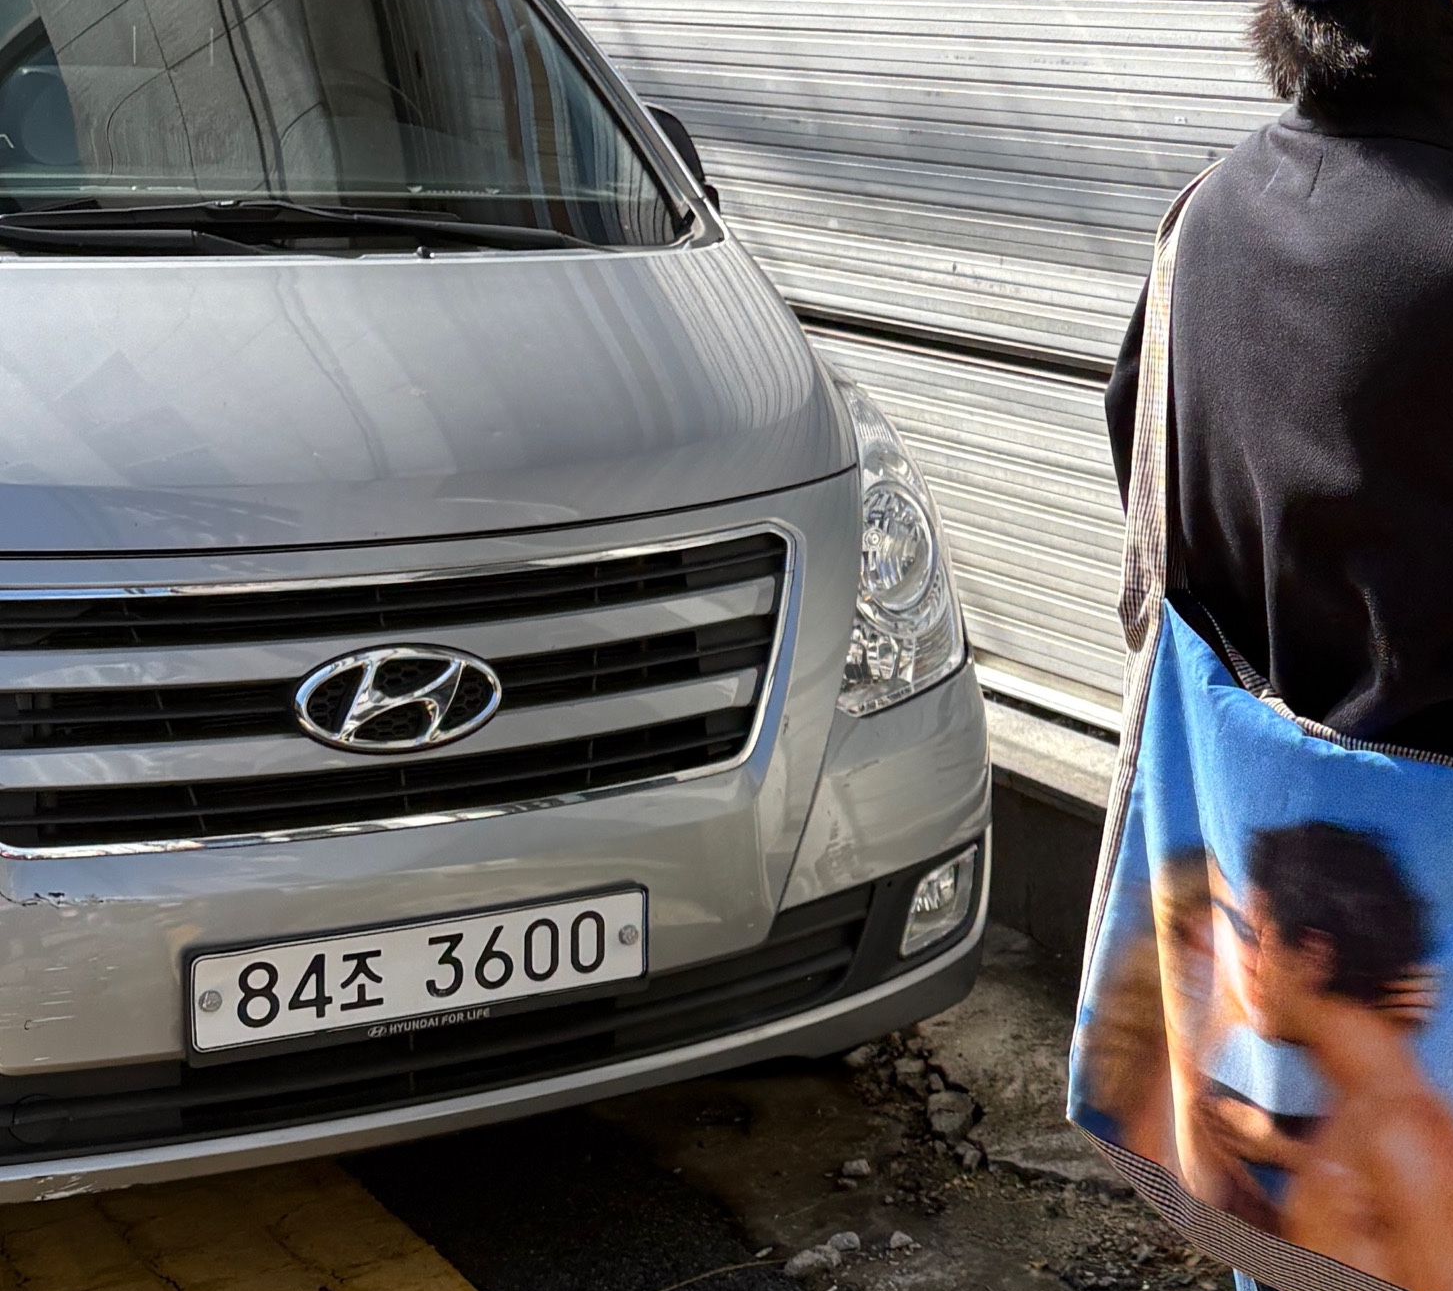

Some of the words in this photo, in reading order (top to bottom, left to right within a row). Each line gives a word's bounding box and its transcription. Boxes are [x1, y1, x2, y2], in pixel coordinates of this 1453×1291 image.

[236, 949, 384, 1029] 84조
[425, 910, 606, 999] 3600
[389, 1016, 439, 1035] HYUNDAI
[441, 1011, 465, 1025] FOR
[466, 1007, 490, 1021] LIFE
